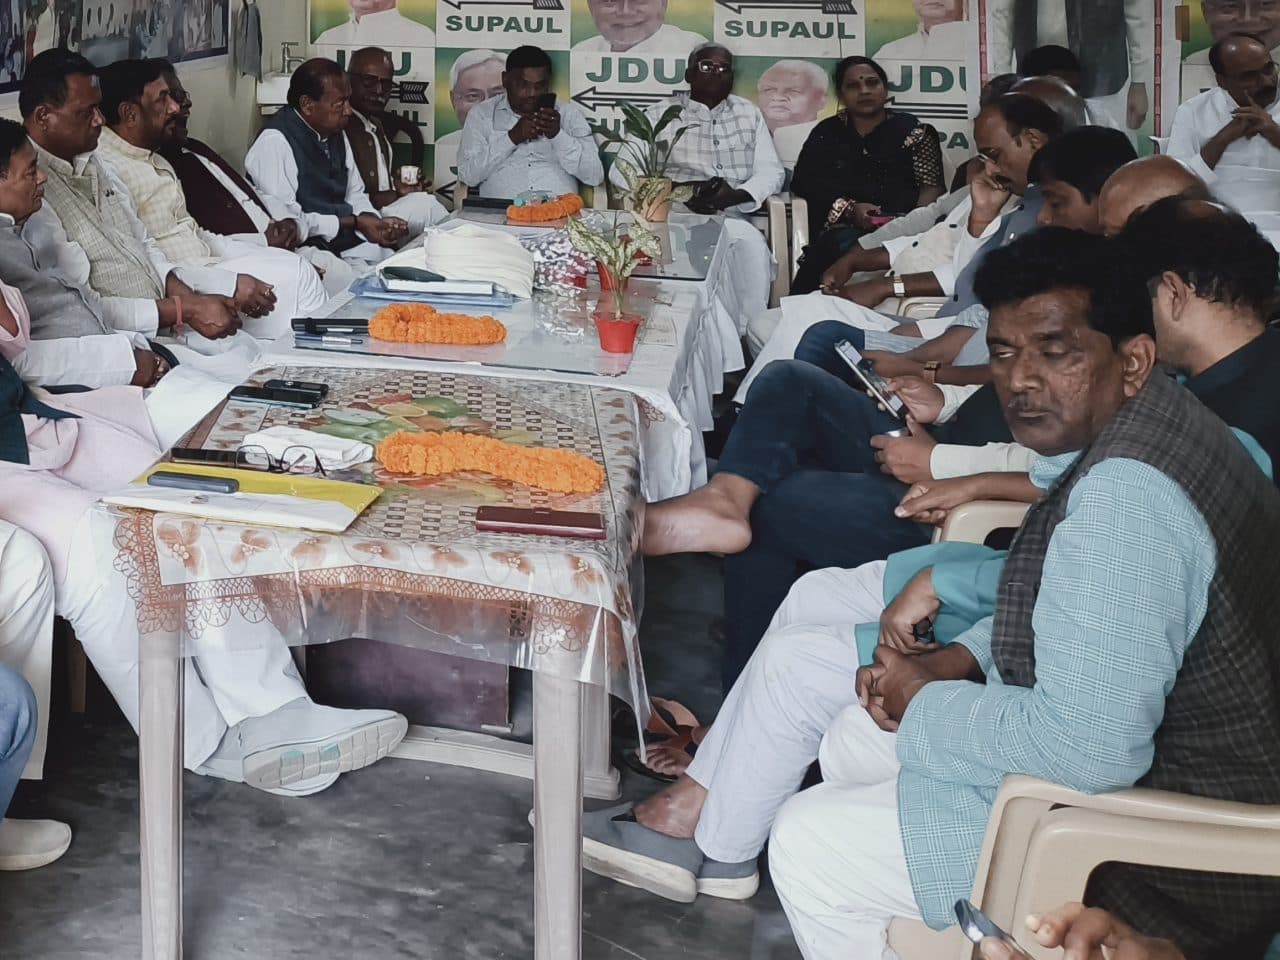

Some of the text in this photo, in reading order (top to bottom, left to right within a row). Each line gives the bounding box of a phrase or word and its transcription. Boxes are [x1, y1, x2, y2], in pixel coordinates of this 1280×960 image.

[446, 15, 562, 33] SUPAUL
[725, 20, 856, 39] SUPAUL
[585, 57, 687, 84] JDU
